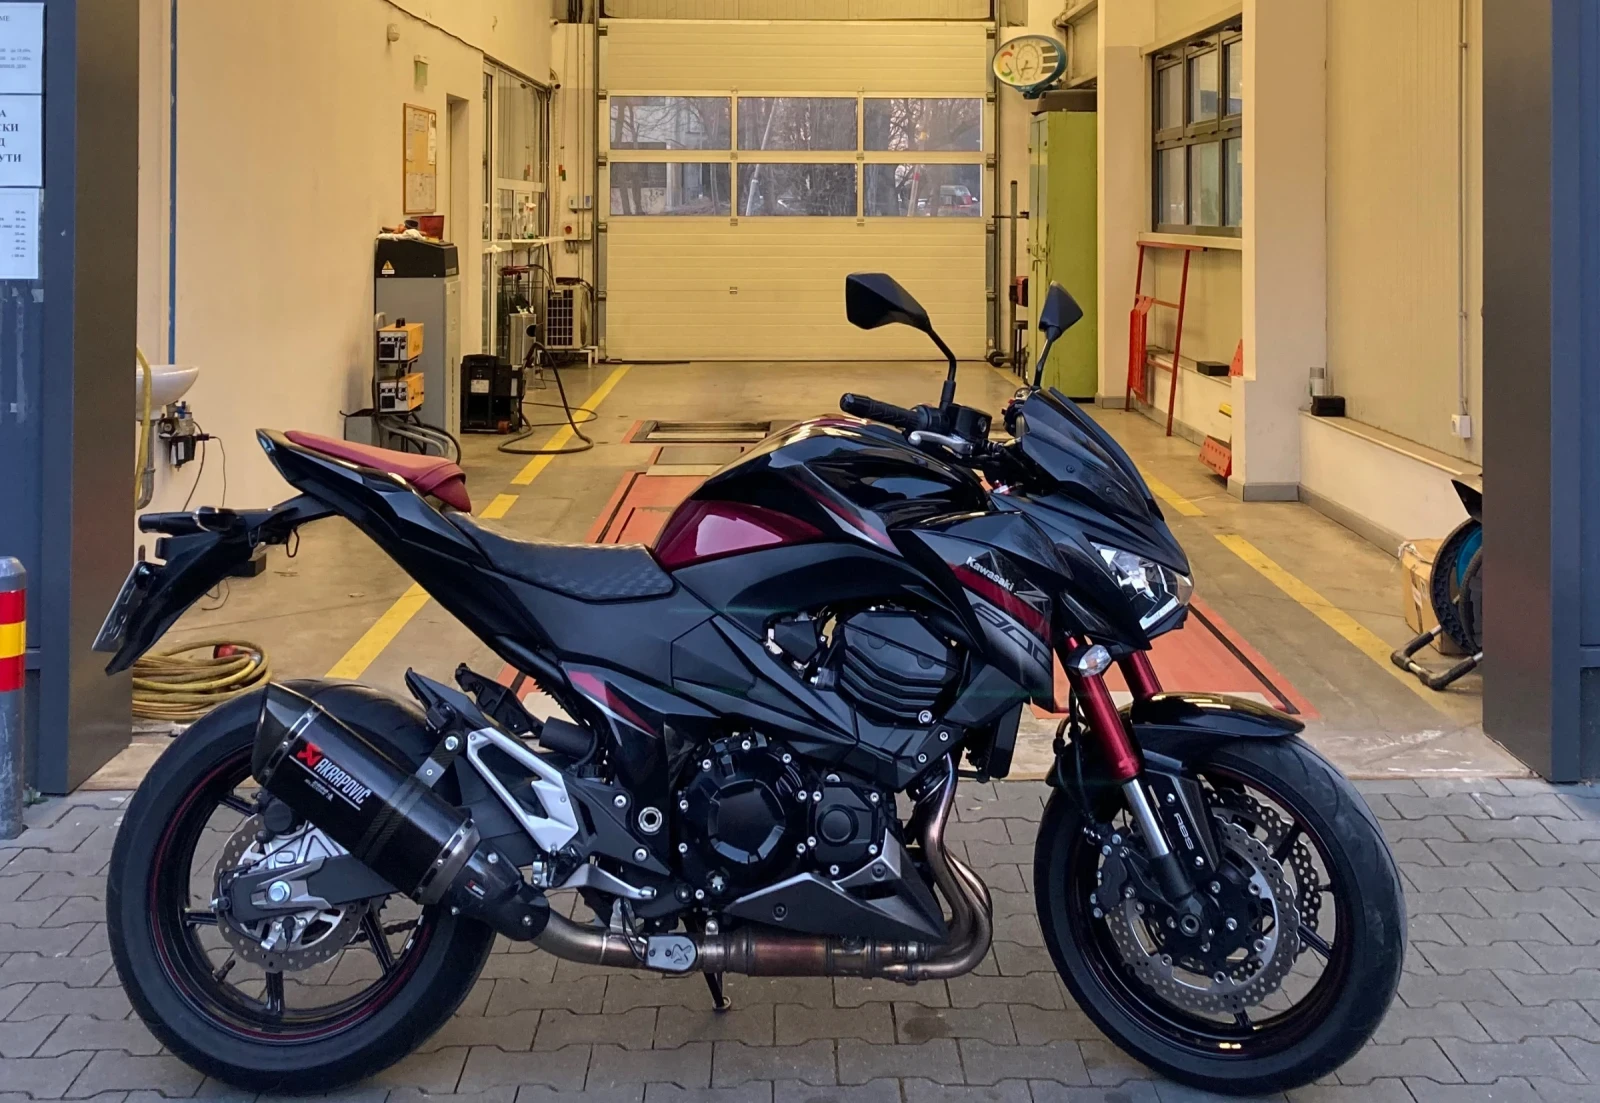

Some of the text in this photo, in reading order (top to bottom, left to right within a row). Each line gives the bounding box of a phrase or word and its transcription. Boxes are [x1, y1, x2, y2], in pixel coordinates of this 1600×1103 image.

[0, 123, 19, 132] КИ
[966, 556, 1014, 591] Kawasaki
[1174, 812, 1195, 850] ABS
